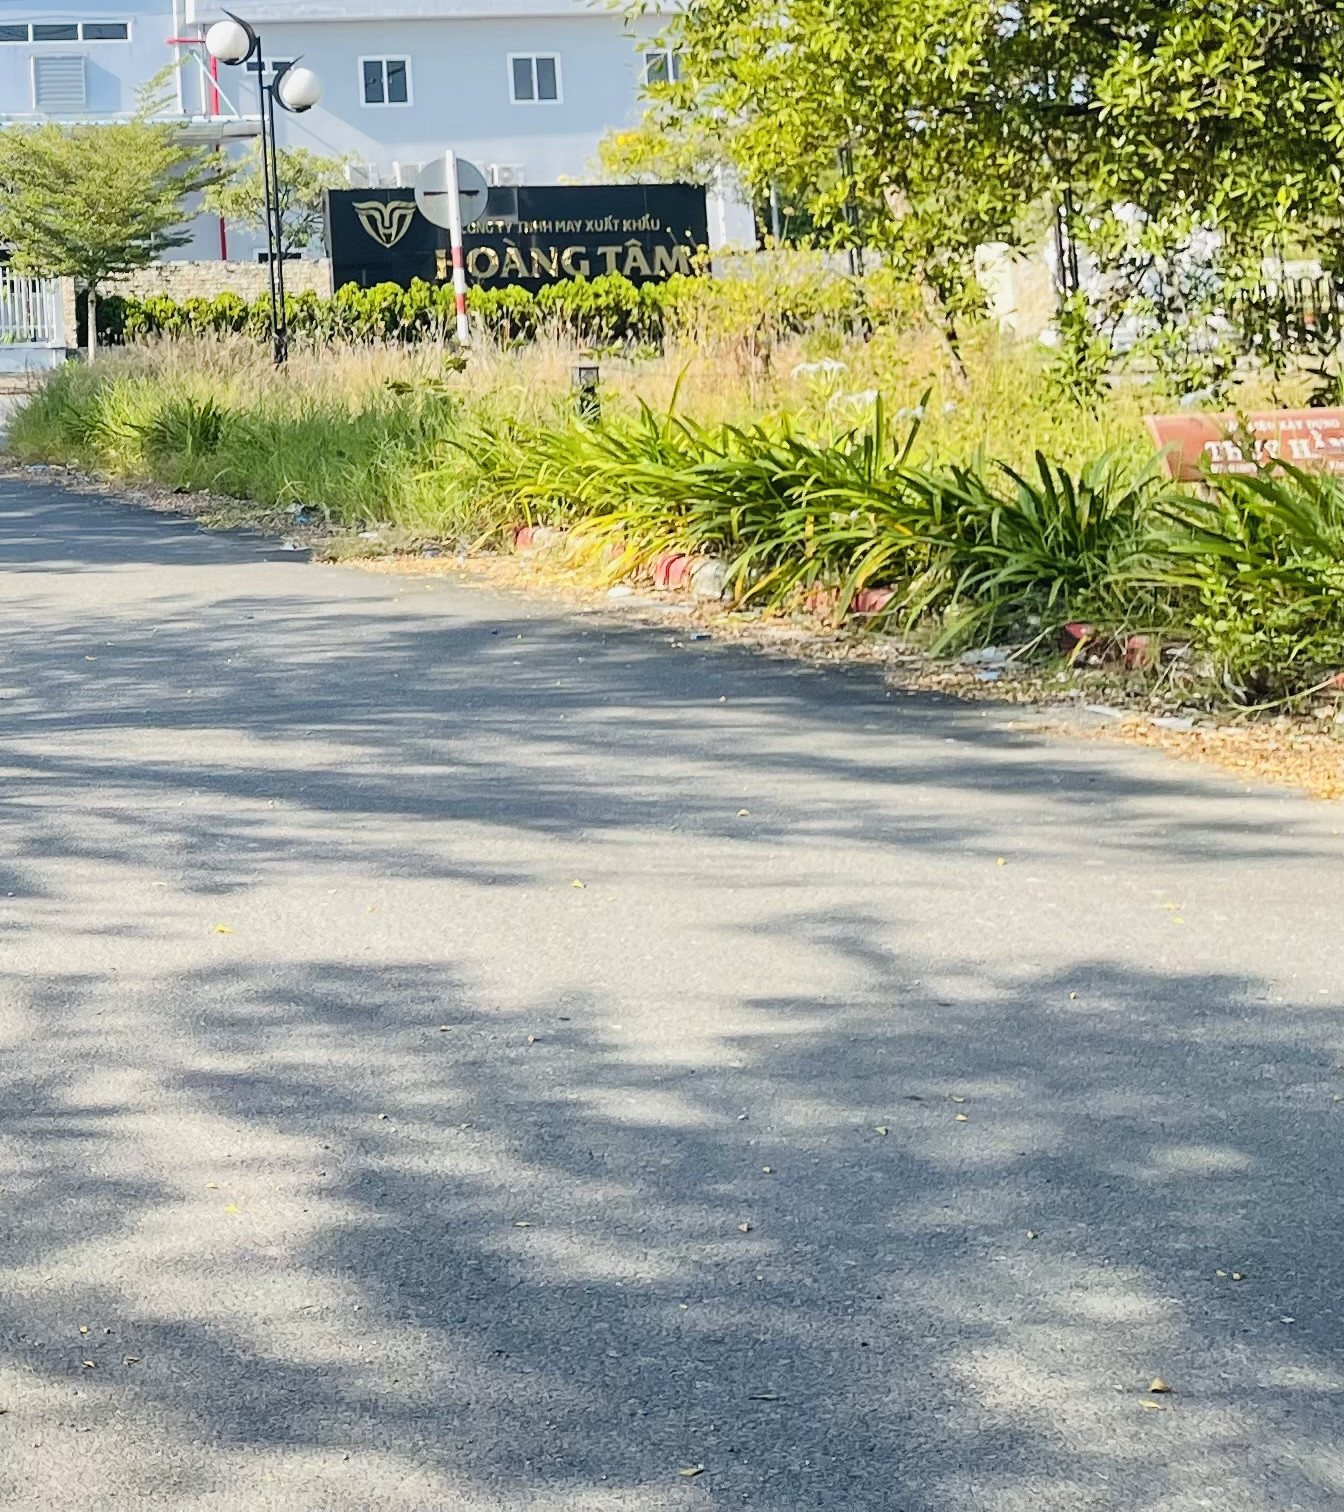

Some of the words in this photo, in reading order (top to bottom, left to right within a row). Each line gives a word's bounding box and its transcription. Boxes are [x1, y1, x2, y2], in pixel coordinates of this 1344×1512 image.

[495, 220, 512, 234] TY
[554, 219, 582, 234] MAY
[585, 215, 621, 233] XUẤT
[597, 238, 692, 276] TÂM
